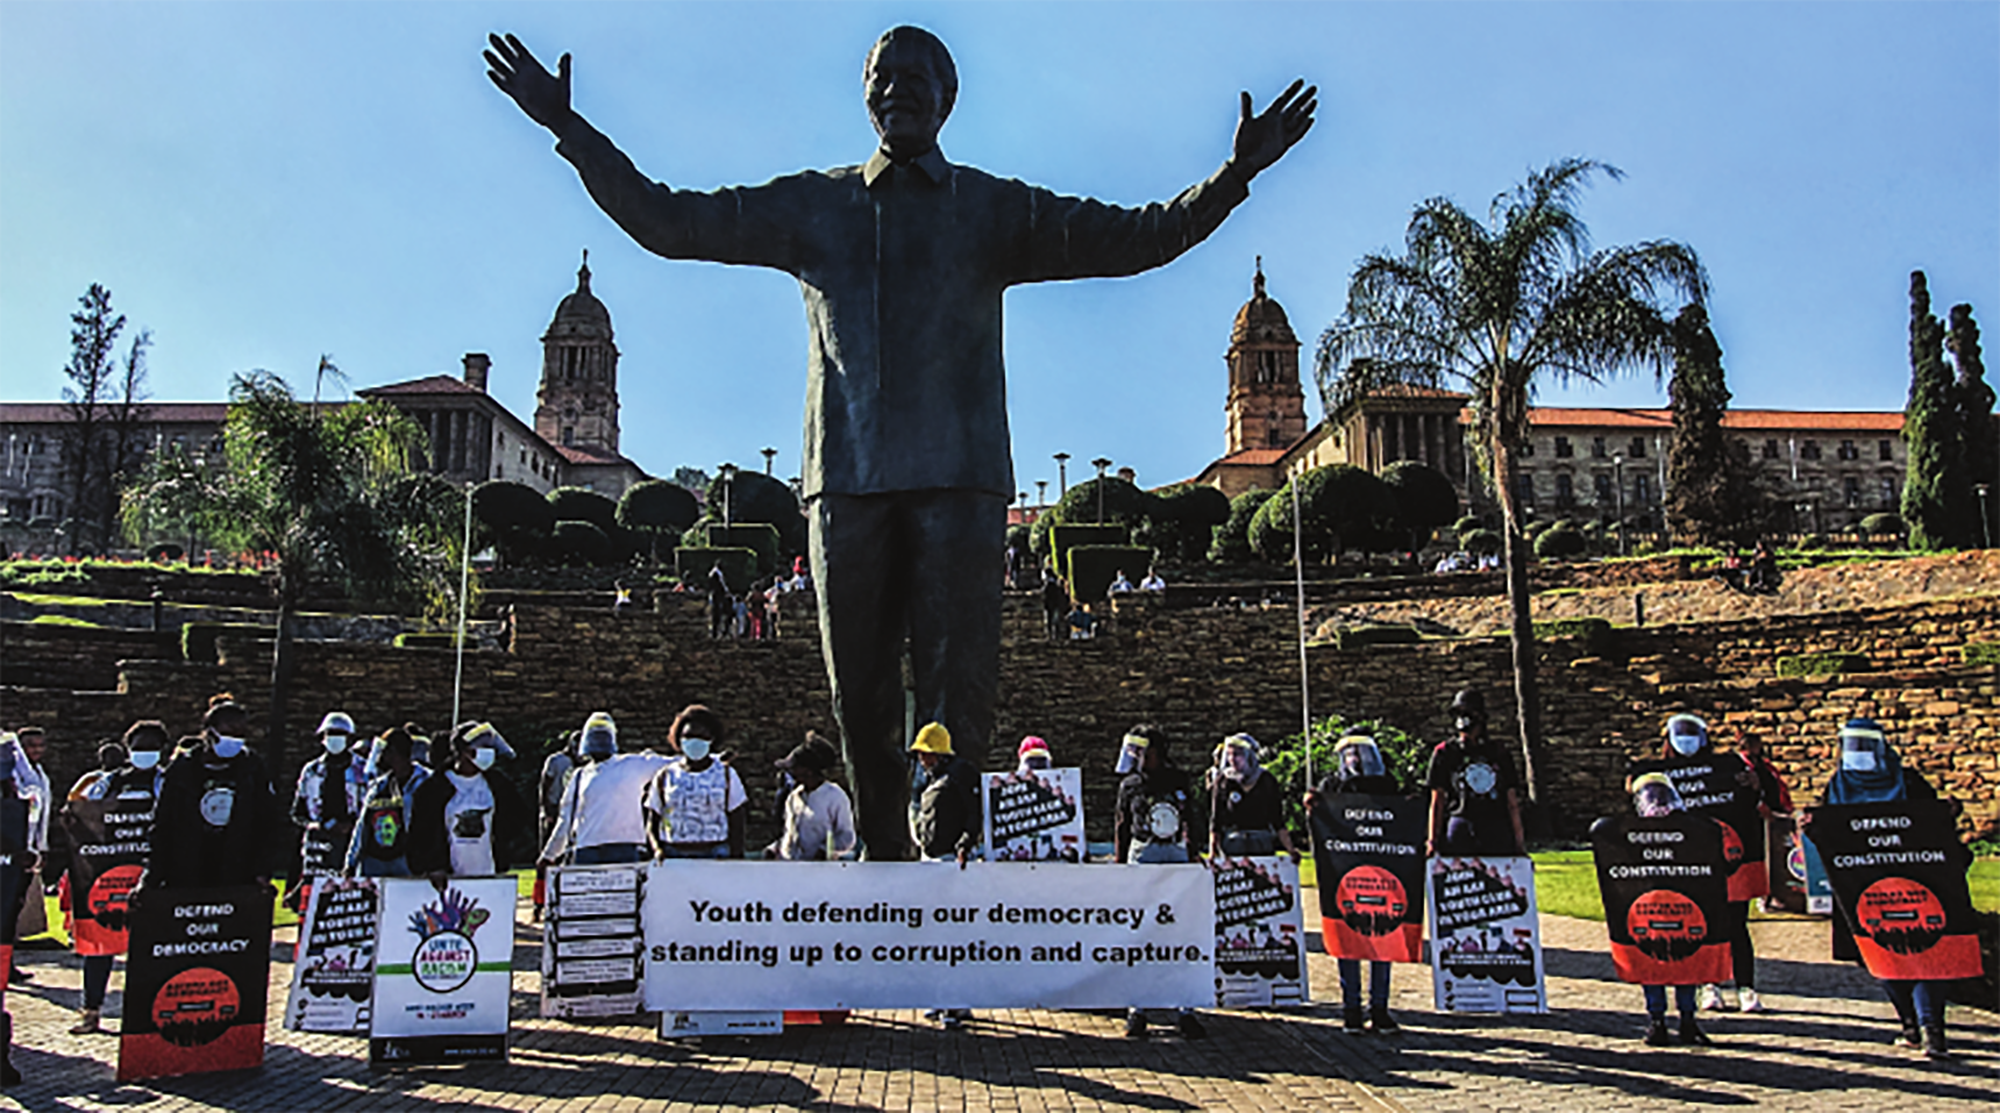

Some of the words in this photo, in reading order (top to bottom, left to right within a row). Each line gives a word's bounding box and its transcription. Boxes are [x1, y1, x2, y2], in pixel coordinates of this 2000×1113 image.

[1345, 808, 1394, 820] DEFEND
[1356, 825, 1383, 836] OUR
[1850, 816, 1912, 831] DEFEND
[1627, 831, 1684, 844] DEFEND
[1867, 834, 1902, 847] OUR
[1325, 839, 1416, 855] CONSTITUTION
[1642, 848, 1675, 860] OUR
[1833, 850, 1945, 868] CONSTITUTION
[1445, 871, 1476, 883] JOIN
[1609, 865, 1712, 878] CONSTITUTION
[1219, 894, 1250, 909] OUTH
[1439, 896, 1480, 911] YOUTH
[174, 903, 235, 918] DEFEND
[690, 900, 773, 923] Youth
[782, 902, 923, 929] defending
[932, 907, 979, 923] our
[987, 903, 1145, 930] democracy
[1155, 904, 1175, 924] &
[1489, 902, 1521, 917] AREA
[186, 923, 219, 936] OUR
[152, 939, 250, 957] DEMOCRACY
[651, 940, 779, 967] standing
[790, 946, 823, 967] up
[833, 942, 862, 962] to
[871, 941, 1022, 967] corruption
[1030, 941, 1082, 962] and
[1092, 942, 1209, 967] capture.
[422, 951, 470, 961] AGAINST
[421, 962, 467, 974] RACISM
